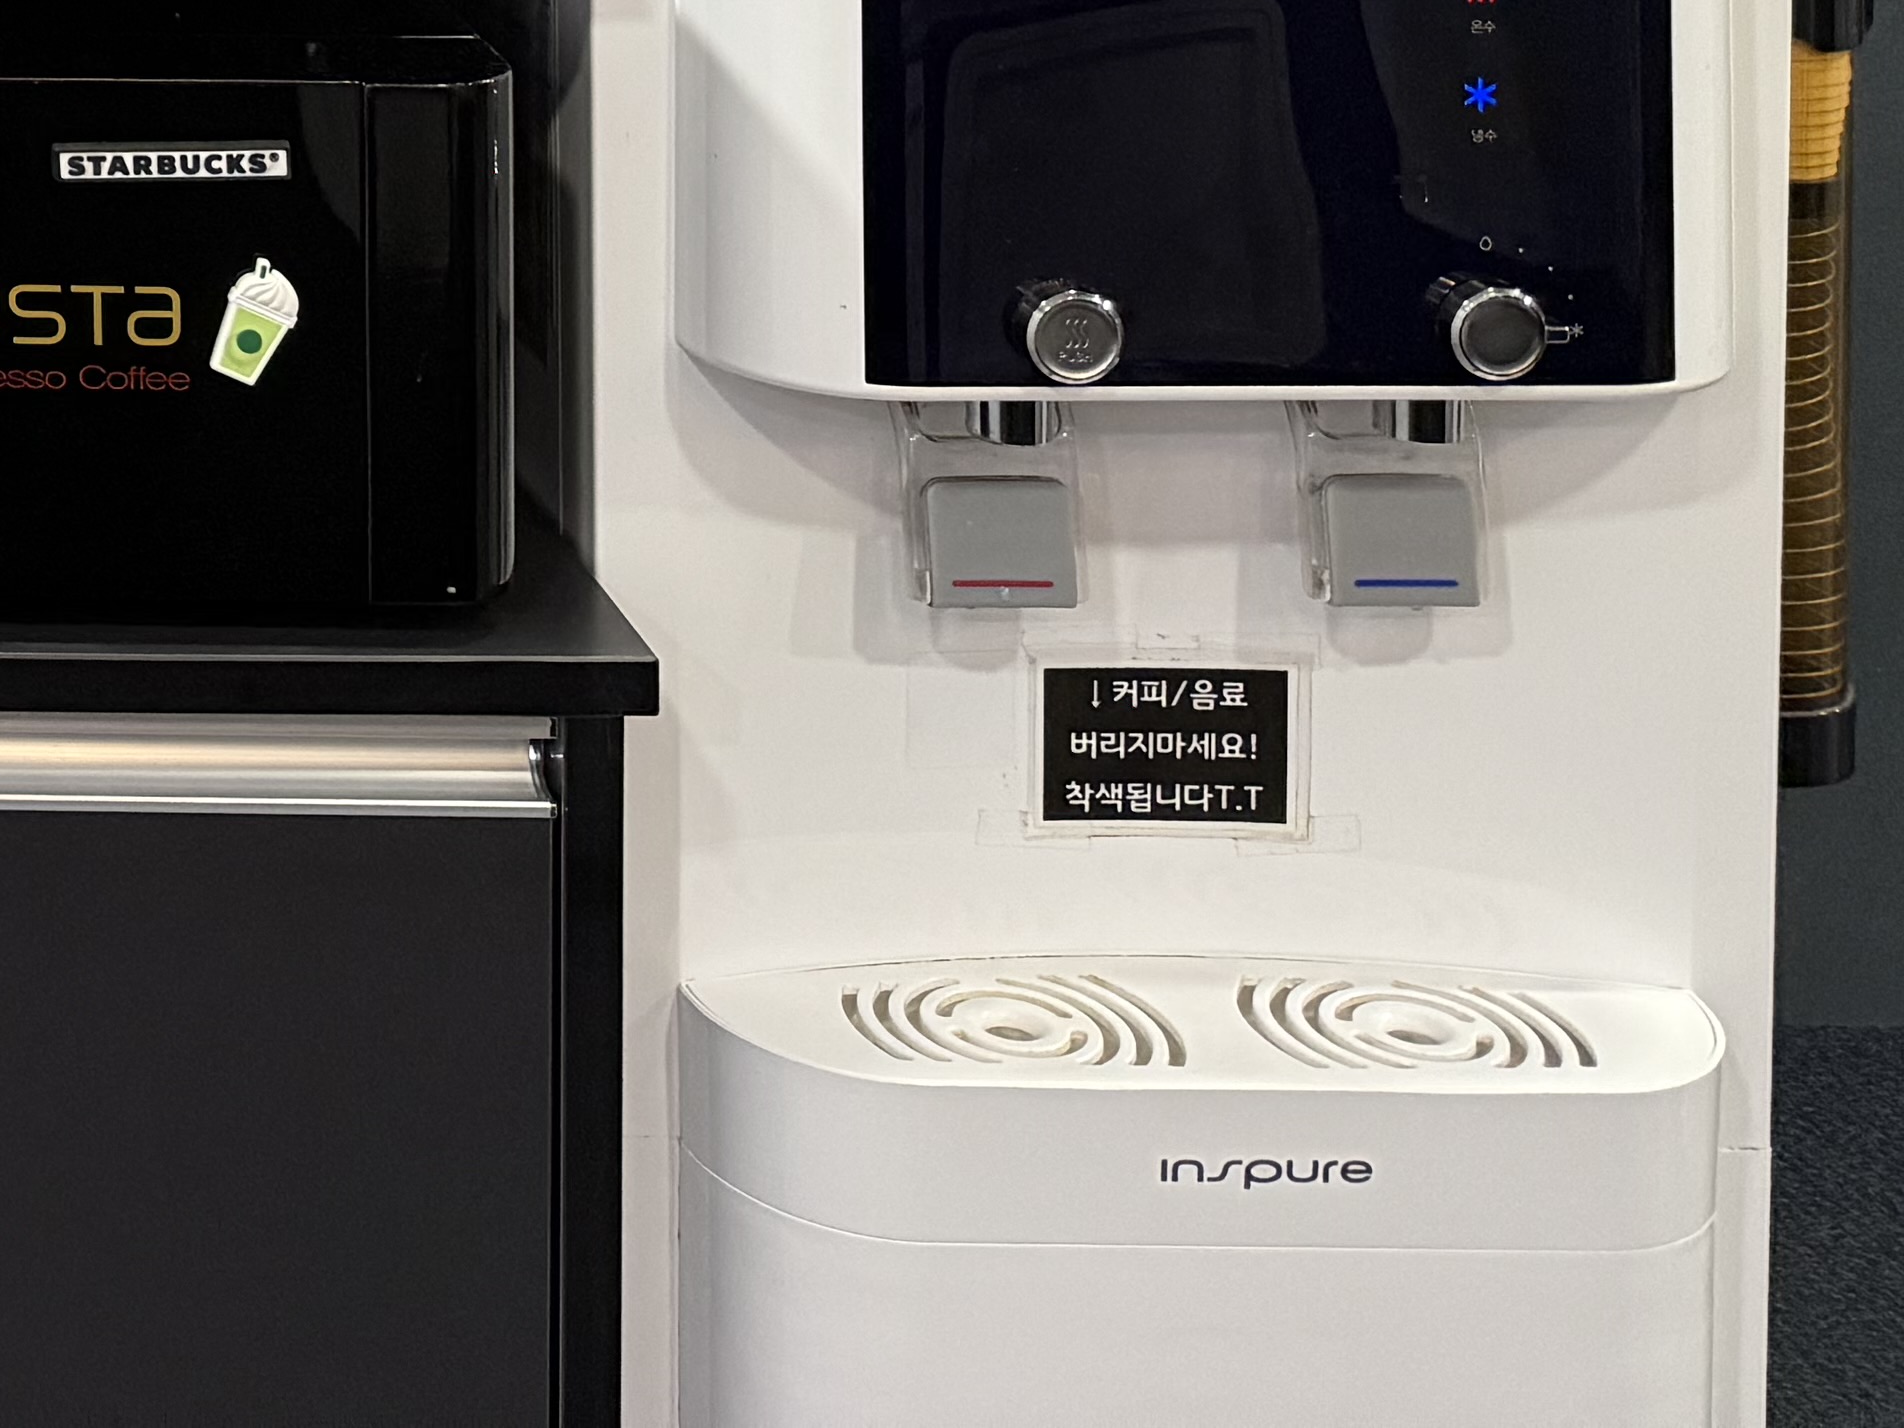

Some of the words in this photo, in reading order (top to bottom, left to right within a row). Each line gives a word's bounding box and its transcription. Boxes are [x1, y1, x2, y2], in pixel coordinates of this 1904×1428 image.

[78, 364, 191, 391] Coffee
[1111, 679, 1249, 711] 커피/음료
[1069, 731, 1258, 761] 버리지마세요!
[1064, 780, 1265, 813] 착색됩니다T.T
[1159, 1159, 1374, 1190] inspure
